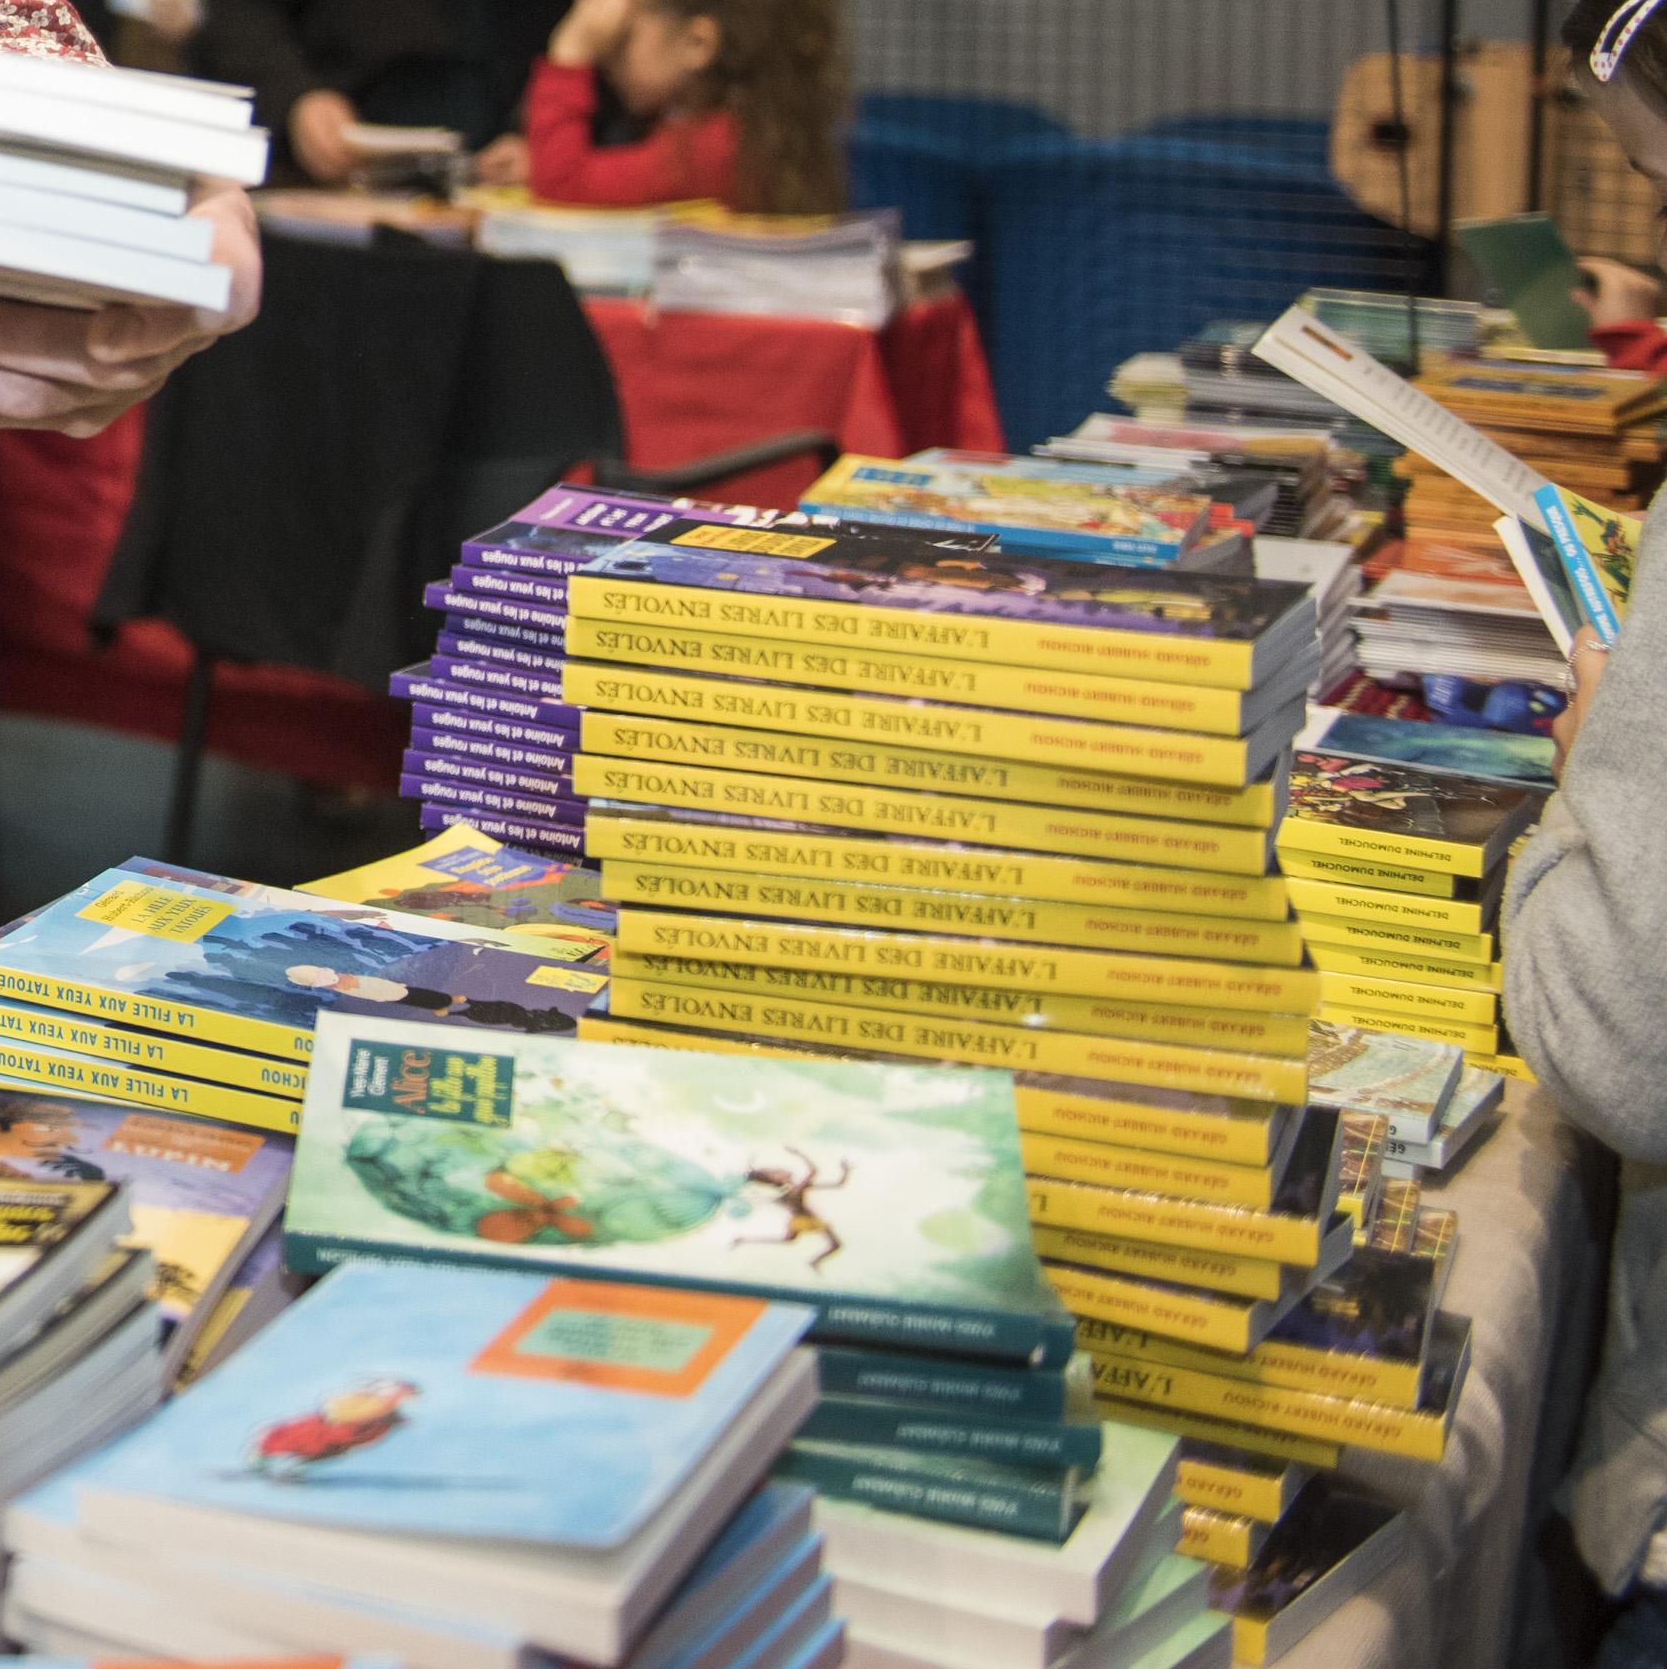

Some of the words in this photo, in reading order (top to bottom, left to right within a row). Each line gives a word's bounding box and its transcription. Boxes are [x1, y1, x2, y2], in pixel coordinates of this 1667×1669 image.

[444, 594, 477, 614] rouges
[479, 599, 502, 616] yeux
[503, 605, 517, 620] les
[602, 591, 711, 622] ENVOLÉS
[519, 609, 529, 622] et
[532, 611, 565, 629] Antoine
[721, 604, 804, 629] LIVRES
[814, 614, 859, 636] DES
[869, 620, 989, 649] L'AFFAIRE
[596, 680, 703, 708] ENVOLÉS
[714, 694, 797, 720] LIVRES
[807, 706, 852, 727] DES
[432, 712, 468, 730] rouges
[432, 713, 466, 731] rouges
[469, 720, 493, 735] yeux
[470, 718, 493, 732] yeux
[495, 723, 510, 737] les
[495, 723, 509, 738] les
[863, 712, 982, 742] L'AFFAIRE
[511, 728, 522, 739] et
[512, 726, 523, 738] et
[524, 729, 564, 747] Antoine
[525, 728, 564, 747] Antoine
[421, 783, 457, 801] rouges
[604, 770, 715, 800] ENVOLÉS
[458, 790, 483, 804] yeux
[485, 795, 501, 808] les
[503, 798, 514, 809] et
[725, 785, 808, 811] LIVRES
[820, 796, 865, 818] DES
[516, 799, 556, 818] Antoine
[875, 802, 997, 833] L'AFFAIRE
[1338, 838, 1401, 854] DUMOUCHEL
[1405, 848, 1451, 862] DELPHINE
[1311, 860, 1373, 876] DUMOUCHEL
[1376, 869, 1424, 882] DELPHINE
[131, 912, 148, 924] LA
[146, 896, 173, 917] FILLE
[1335, 896, 1398, 912] DUMOUCHEL
[1401, 906, 1449, 920] DELPHINE
[148, 916, 170, 932] AUX
[167, 897, 197, 916] YEUX
[170, 905, 213, 933] TATOUÉS
[653, 926, 767, 953] ENVOLÉS
[1346, 926, 1409, 942] DUMOUCHEL
[1412, 934, 1460, 949] DELPHINE
[778, 938, 866, 962] LIVRES
[876, 947, 922, 970] DES
[934, 951, 1057, 980] L'AFFAIRE
[56, 985, 92, 1010] YEUX
[1351, 986, 1414, 1002] DUMOUCHEL
[1417, 995, 1465, 1009] DELPHINE
[99, 995, 127, 1019] AUX
[133, 1002, 171, 1023] FILLE
[640, 992, 752, 1025] ENVOLÉS
[177, 1012, 195, 1028] LA
[763, 1008, 849, 1036] LIVRES
[1351, 1016, 1415, 1032] DUMOUCHEL
[28, 1019, 64, 1043] YEUX
[70, 1028, 97, 1049] AUX
[859, 1020, 904, 1041] DES
[1418, 1026, 1466, 1039] DELPHINE
[103, 1035, 141, 1056] FILLE
[146, 1045, 164, 1061] LA
[915, 1028, 1037, 1060] L'AFFAIRE
[48, 1061, 84, 1082] YEUX
[91, 1070, 120, 1088] AUX
[261, 1068, 305, 1090] ICHOU
[125, 1077, 164, 1099] FILLE
[171, 1087, 188, 1103] LA
[1222, 1392, 1280, 1414] RICHOU
[1283, 1404, 1339, 1425] HUBERT
[1343, 1414, 1401, 1440] GÉRARD
